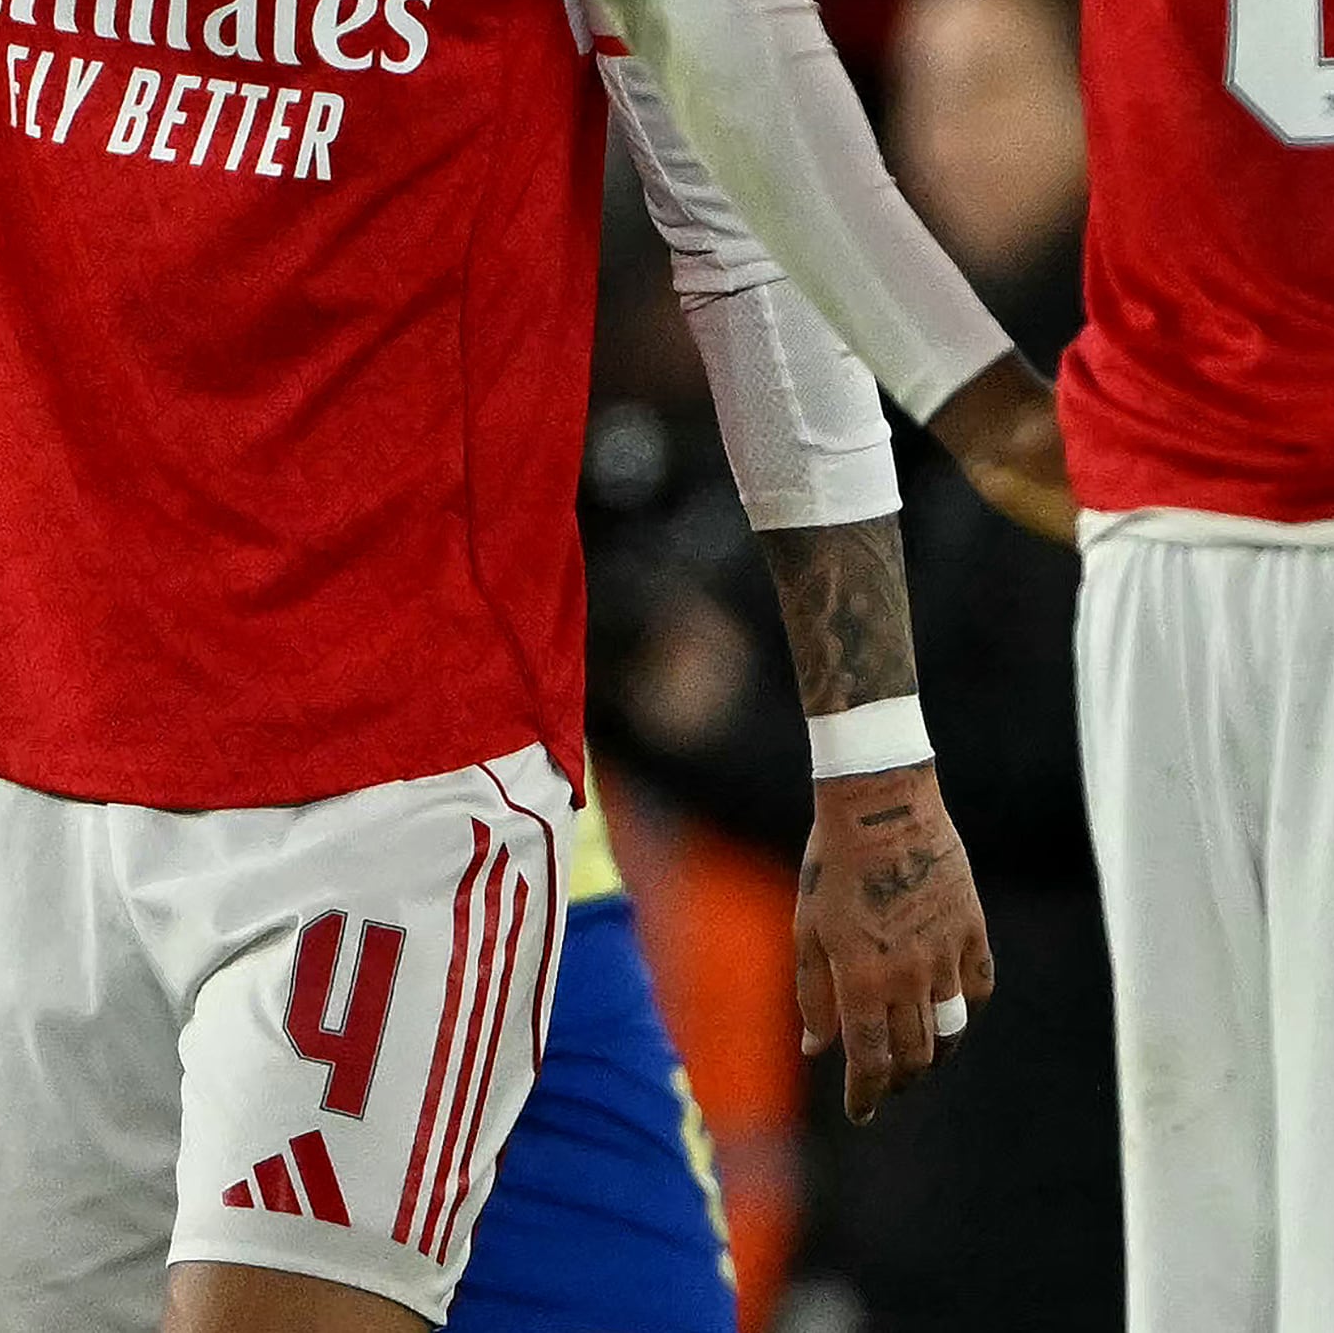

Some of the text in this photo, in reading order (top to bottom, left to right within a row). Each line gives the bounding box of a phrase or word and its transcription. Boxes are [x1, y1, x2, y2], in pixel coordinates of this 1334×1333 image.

[6, 43, 344, 181] FLY BETTER
[283, 909, 406, 1120] 4
